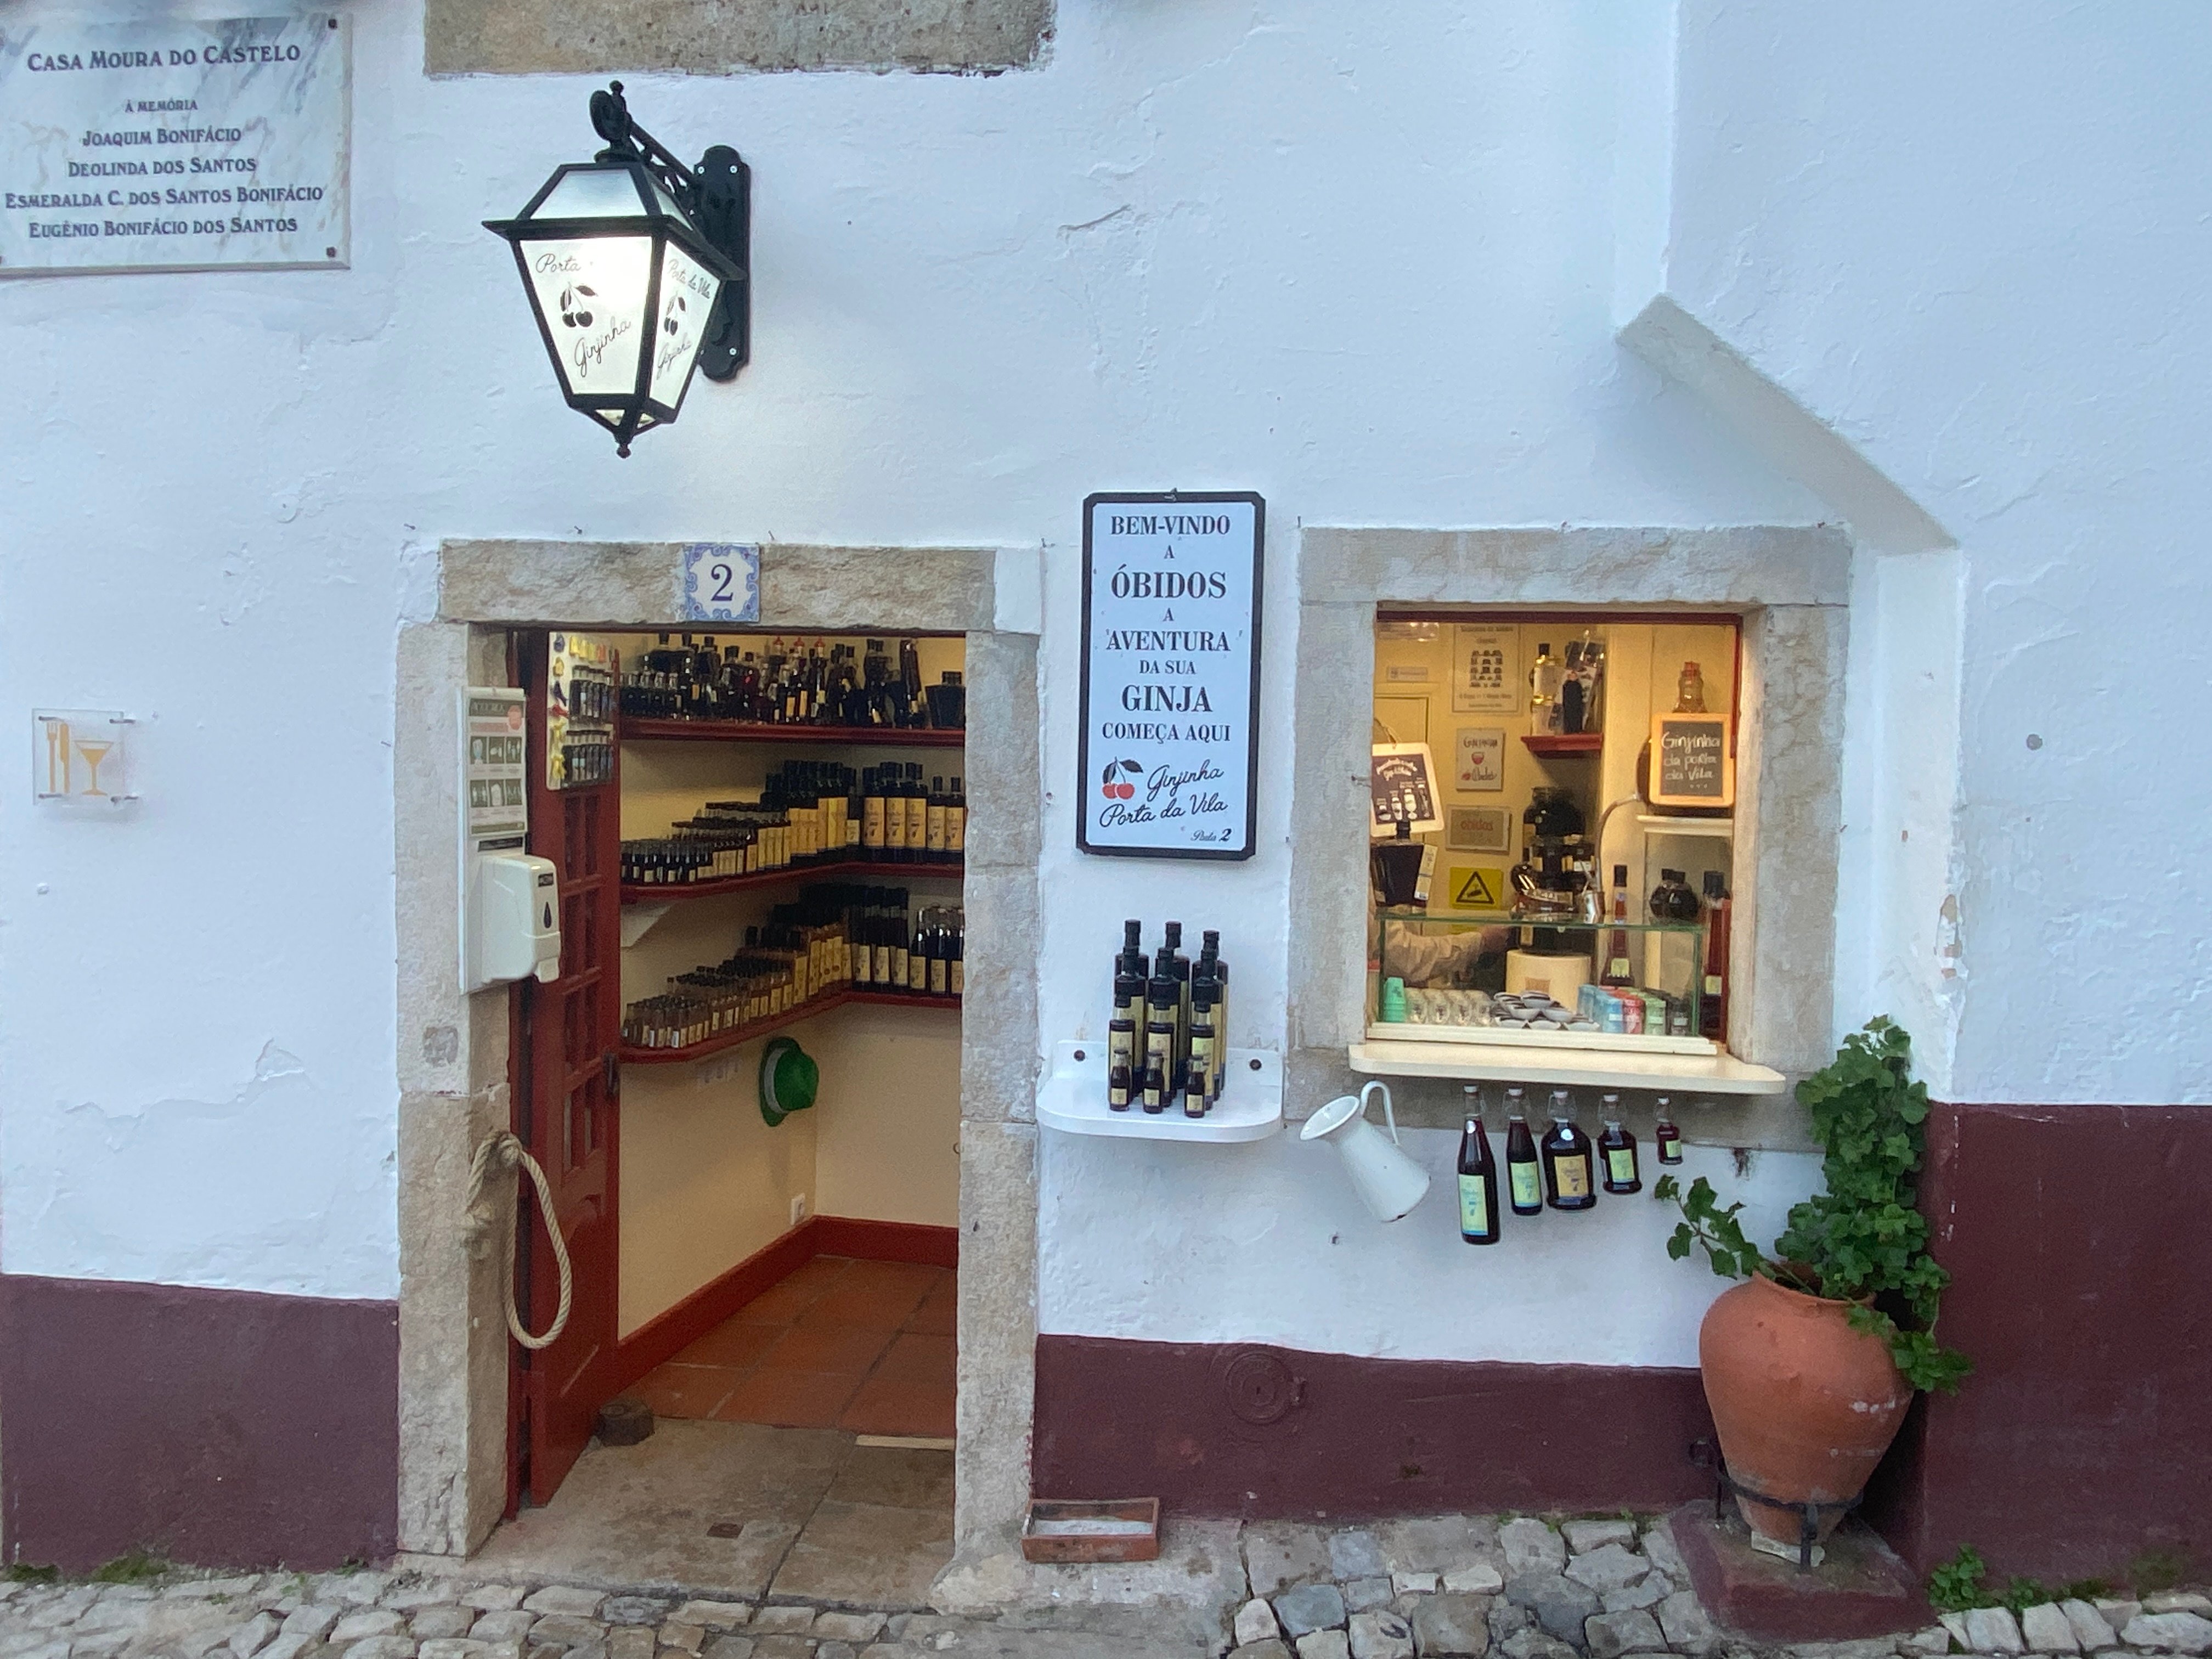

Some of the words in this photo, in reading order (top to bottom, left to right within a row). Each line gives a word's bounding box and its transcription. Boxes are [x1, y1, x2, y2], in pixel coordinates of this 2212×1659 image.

[27, 53, 83, 71] CASA
[89, 51, 163, 70] MOURA
[169, 49, 196, 66] DO
[203, 44, 301, 64] CASTELO
[137, 97, 198, 112] MEMÓRIA
[82, 131, 152, 147] JOAQUIM
[157, 125, 242, 144] BONIFÁCIO
[68, 161, 148, 178] DEOLINDA
[153, 160, 185, 174] DOS
[190, 157, 257, 173] SANTOS
[5, 193, 103, 209] ESMERALDA
[108, 190, 123, 206] C.
[128, 190, 161, 206] DOS
[166, 188, 232, 204] SANTOS
[237, 184, 324, 202] BONIFÁCIO
[104, 218, 188, 236] BONIFÁCIO
[193, 219, 224, 234] DOS
[229, 217, 298, 234] SANTOS
[535, 253, 582, 274] Porta
[574, 316, 633, 378] Ginjinha
[1110, 515, 1231, 535] BEM-VINDO
[1164, 545, 1175, 559] A
[710, 563, 734, 601] 2
[1111, 563, 1227, 599] ÓBIDOS
[1163, 607, 1174, 622] A
[1106, 630, 1231, 651] AVENTURA
[1139, 659, 1160, 674] DA
[1164, 660, 1196, 675] SUA
[1121, 684, 1214, 712] GINJA
[1102, 722, 1180, 744] COMEÇA
[1185, 724, 1231, 743] AQUI
[1147, 759, 1225, 802] Ginjinha
[1099, 803, 1156, 828] Porta
[1160, 797, 1187, 819] da
[1189, 792, 1229, 815] Vila
[1218, 828, 1232, 842] 2
